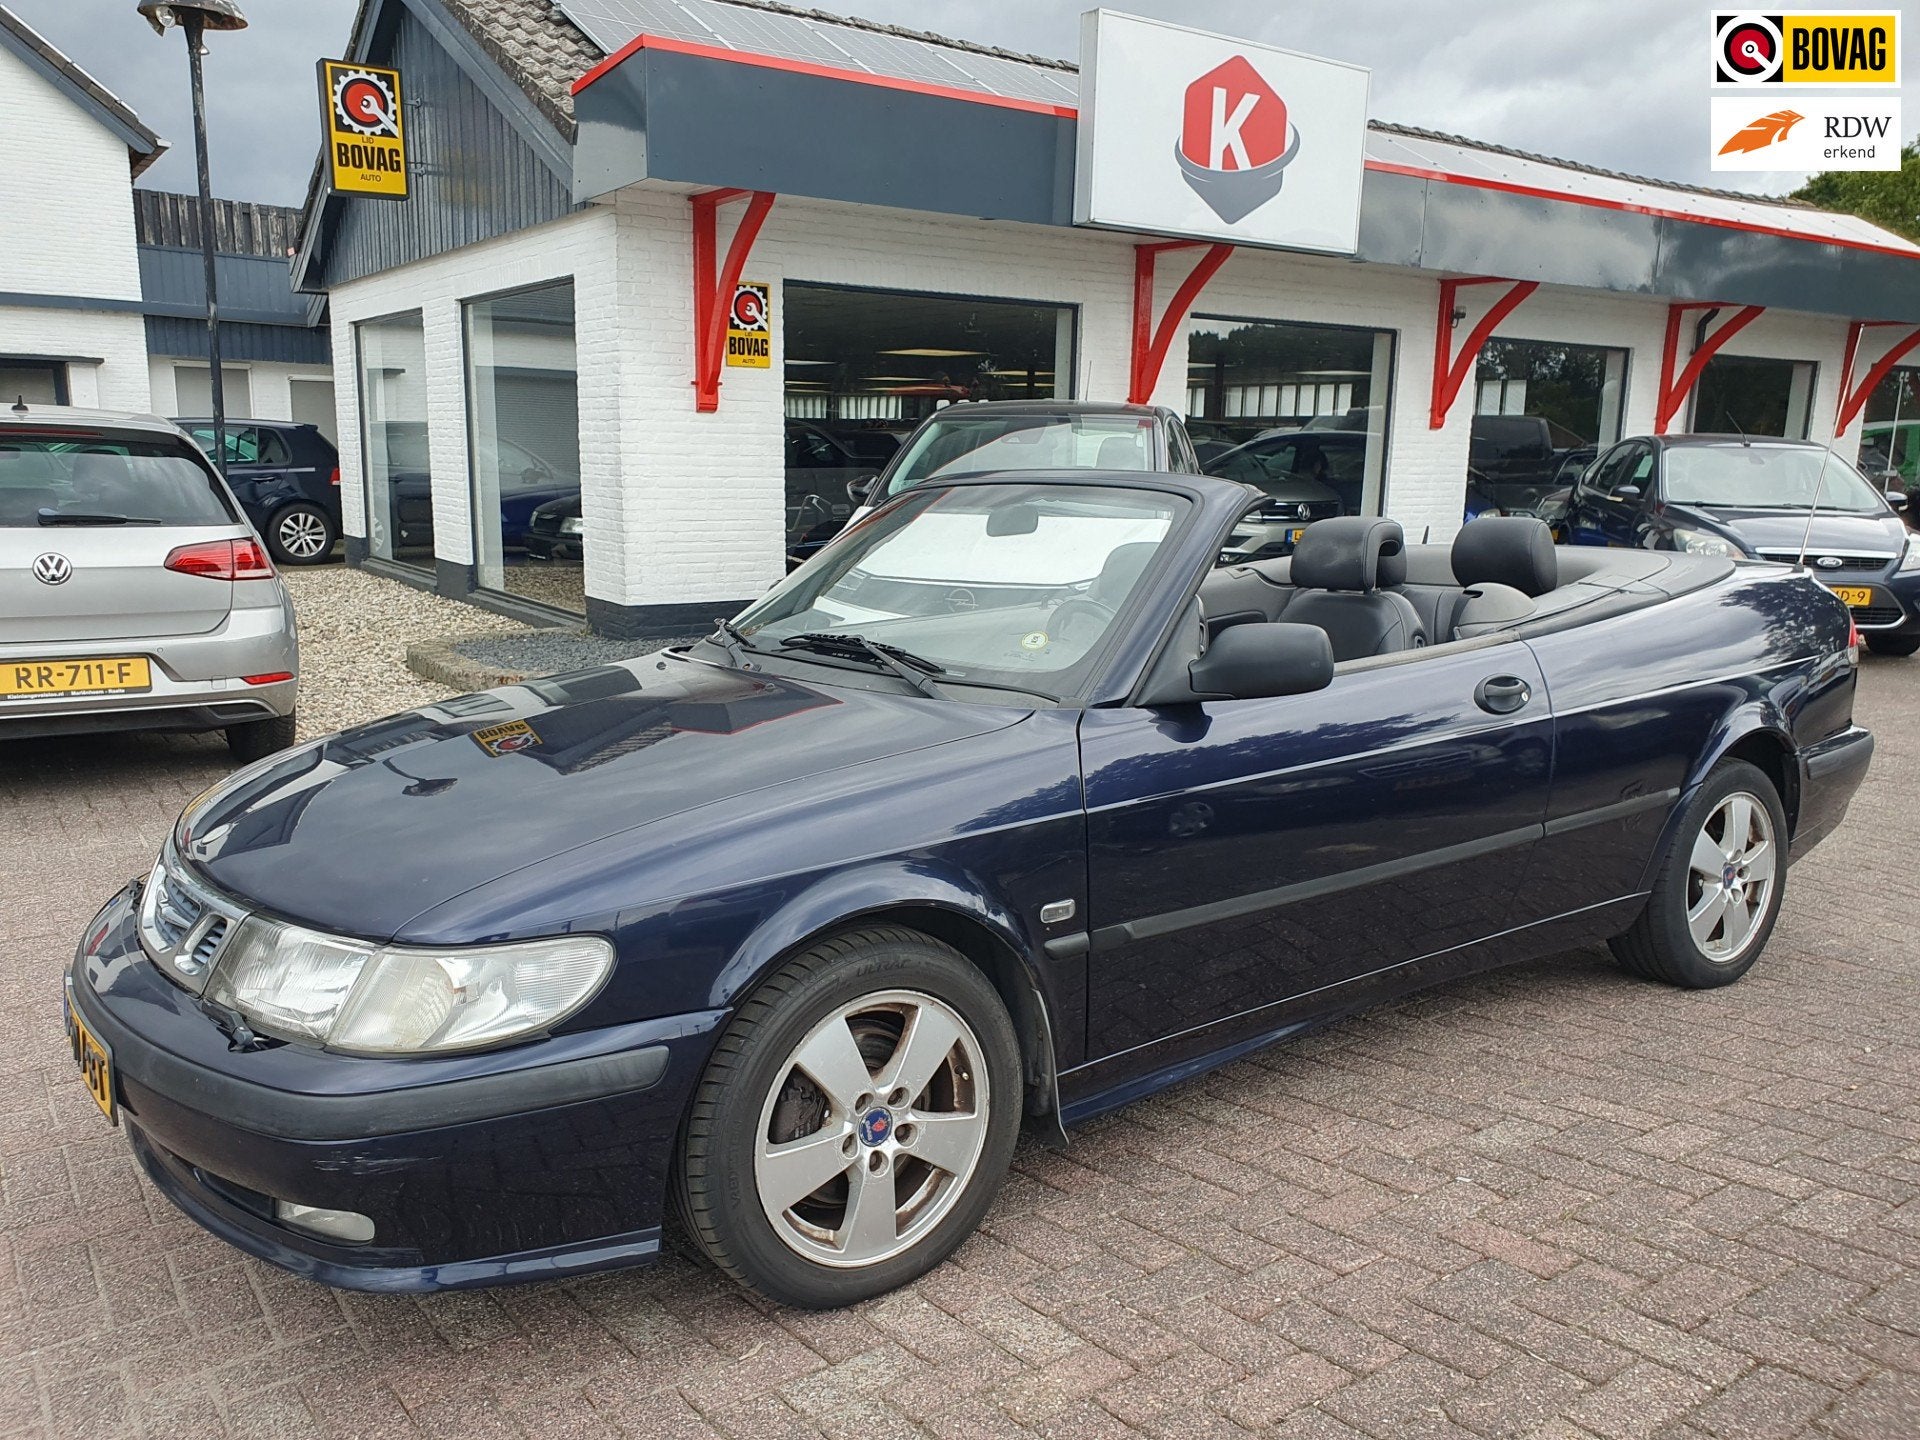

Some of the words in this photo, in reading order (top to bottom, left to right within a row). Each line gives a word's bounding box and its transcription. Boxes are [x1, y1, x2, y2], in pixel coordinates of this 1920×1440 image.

[361, 136, 374, 144] LID
[1209, 87, 1261, 171] K
[336, 142, 401, 173] BOVAG
[360, 173, 381, 183] AUTO
[729, 336, 769, 357] BOVAG
[15, 663, 131, 689] RR-711-F
